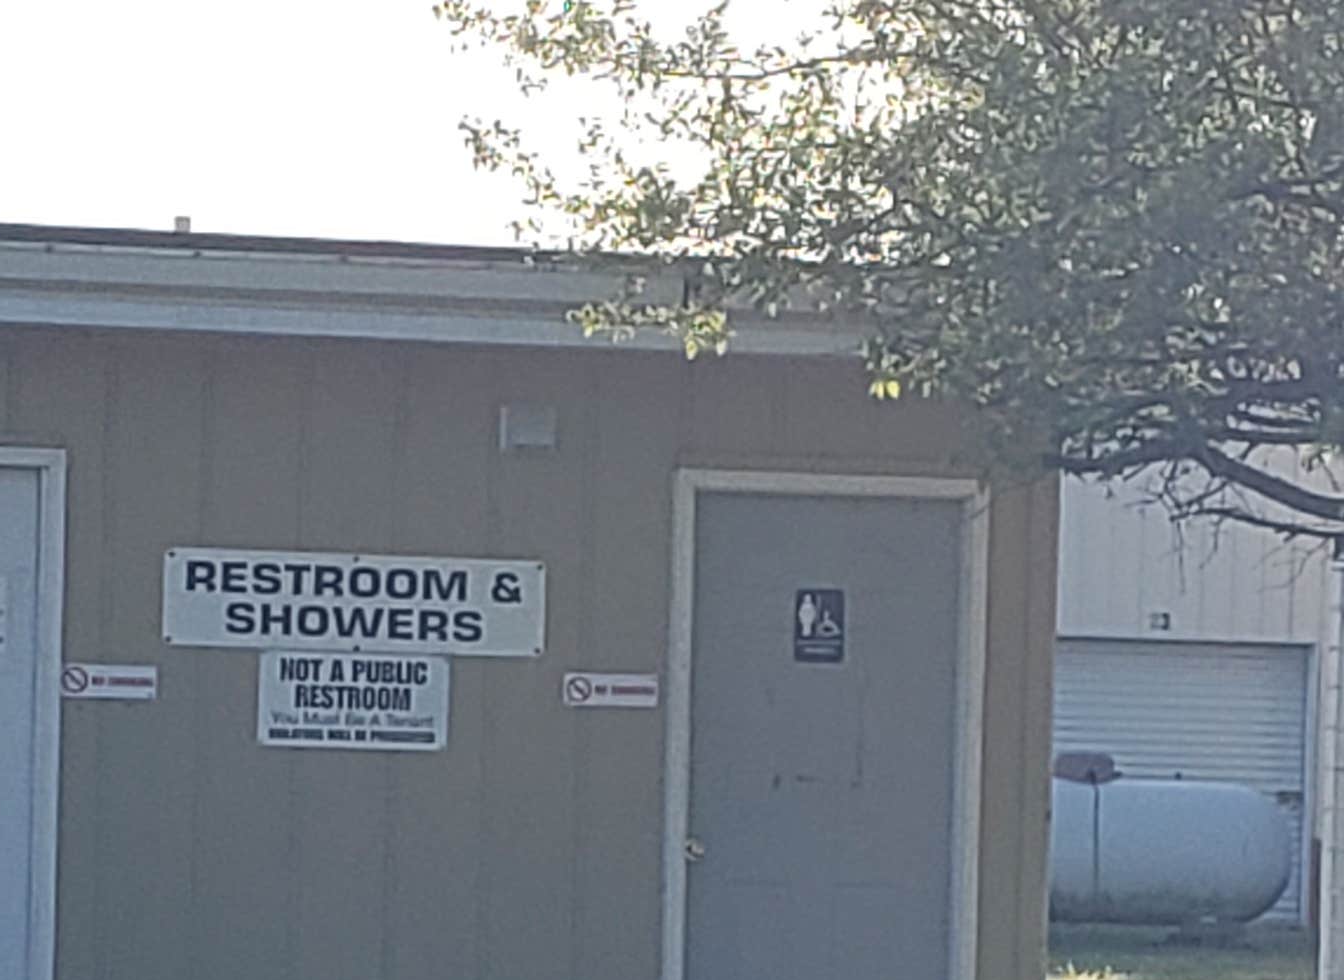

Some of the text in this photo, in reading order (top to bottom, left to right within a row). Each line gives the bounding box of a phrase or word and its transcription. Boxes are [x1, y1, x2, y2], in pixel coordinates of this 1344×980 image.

[184, 560, 522, 604] RESTROOM &
[225, 602, 483, 643] SHOWERS
[280, 657, 428, 685] NOT A PUBLIC
[294, 684, 412, 711] RESTROOM
[270, 711, 434, 728] You Must Be A Tenant
